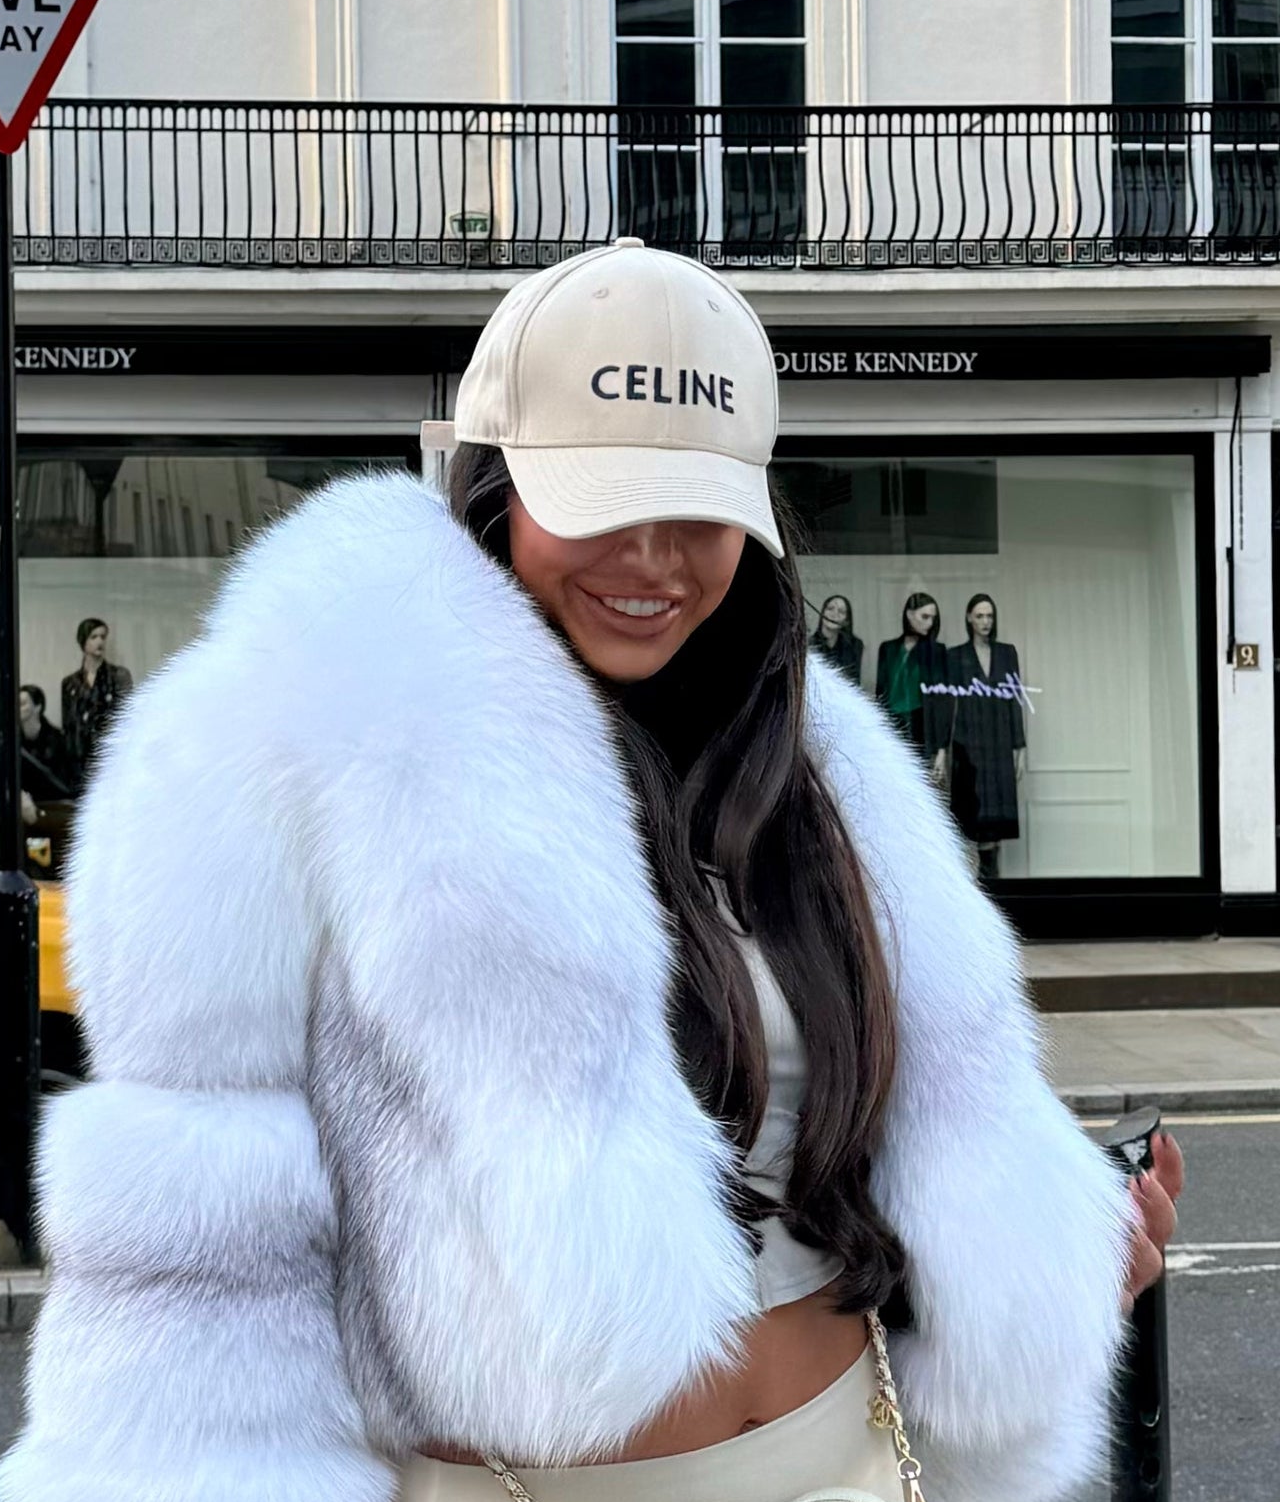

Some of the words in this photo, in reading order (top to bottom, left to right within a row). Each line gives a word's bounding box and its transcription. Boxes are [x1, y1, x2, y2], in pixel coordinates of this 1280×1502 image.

[772, 351, 849, 374] OUISE
[854, 351, 979, 374] KENNEDY
[590, 364, 736, 415] CELINE
